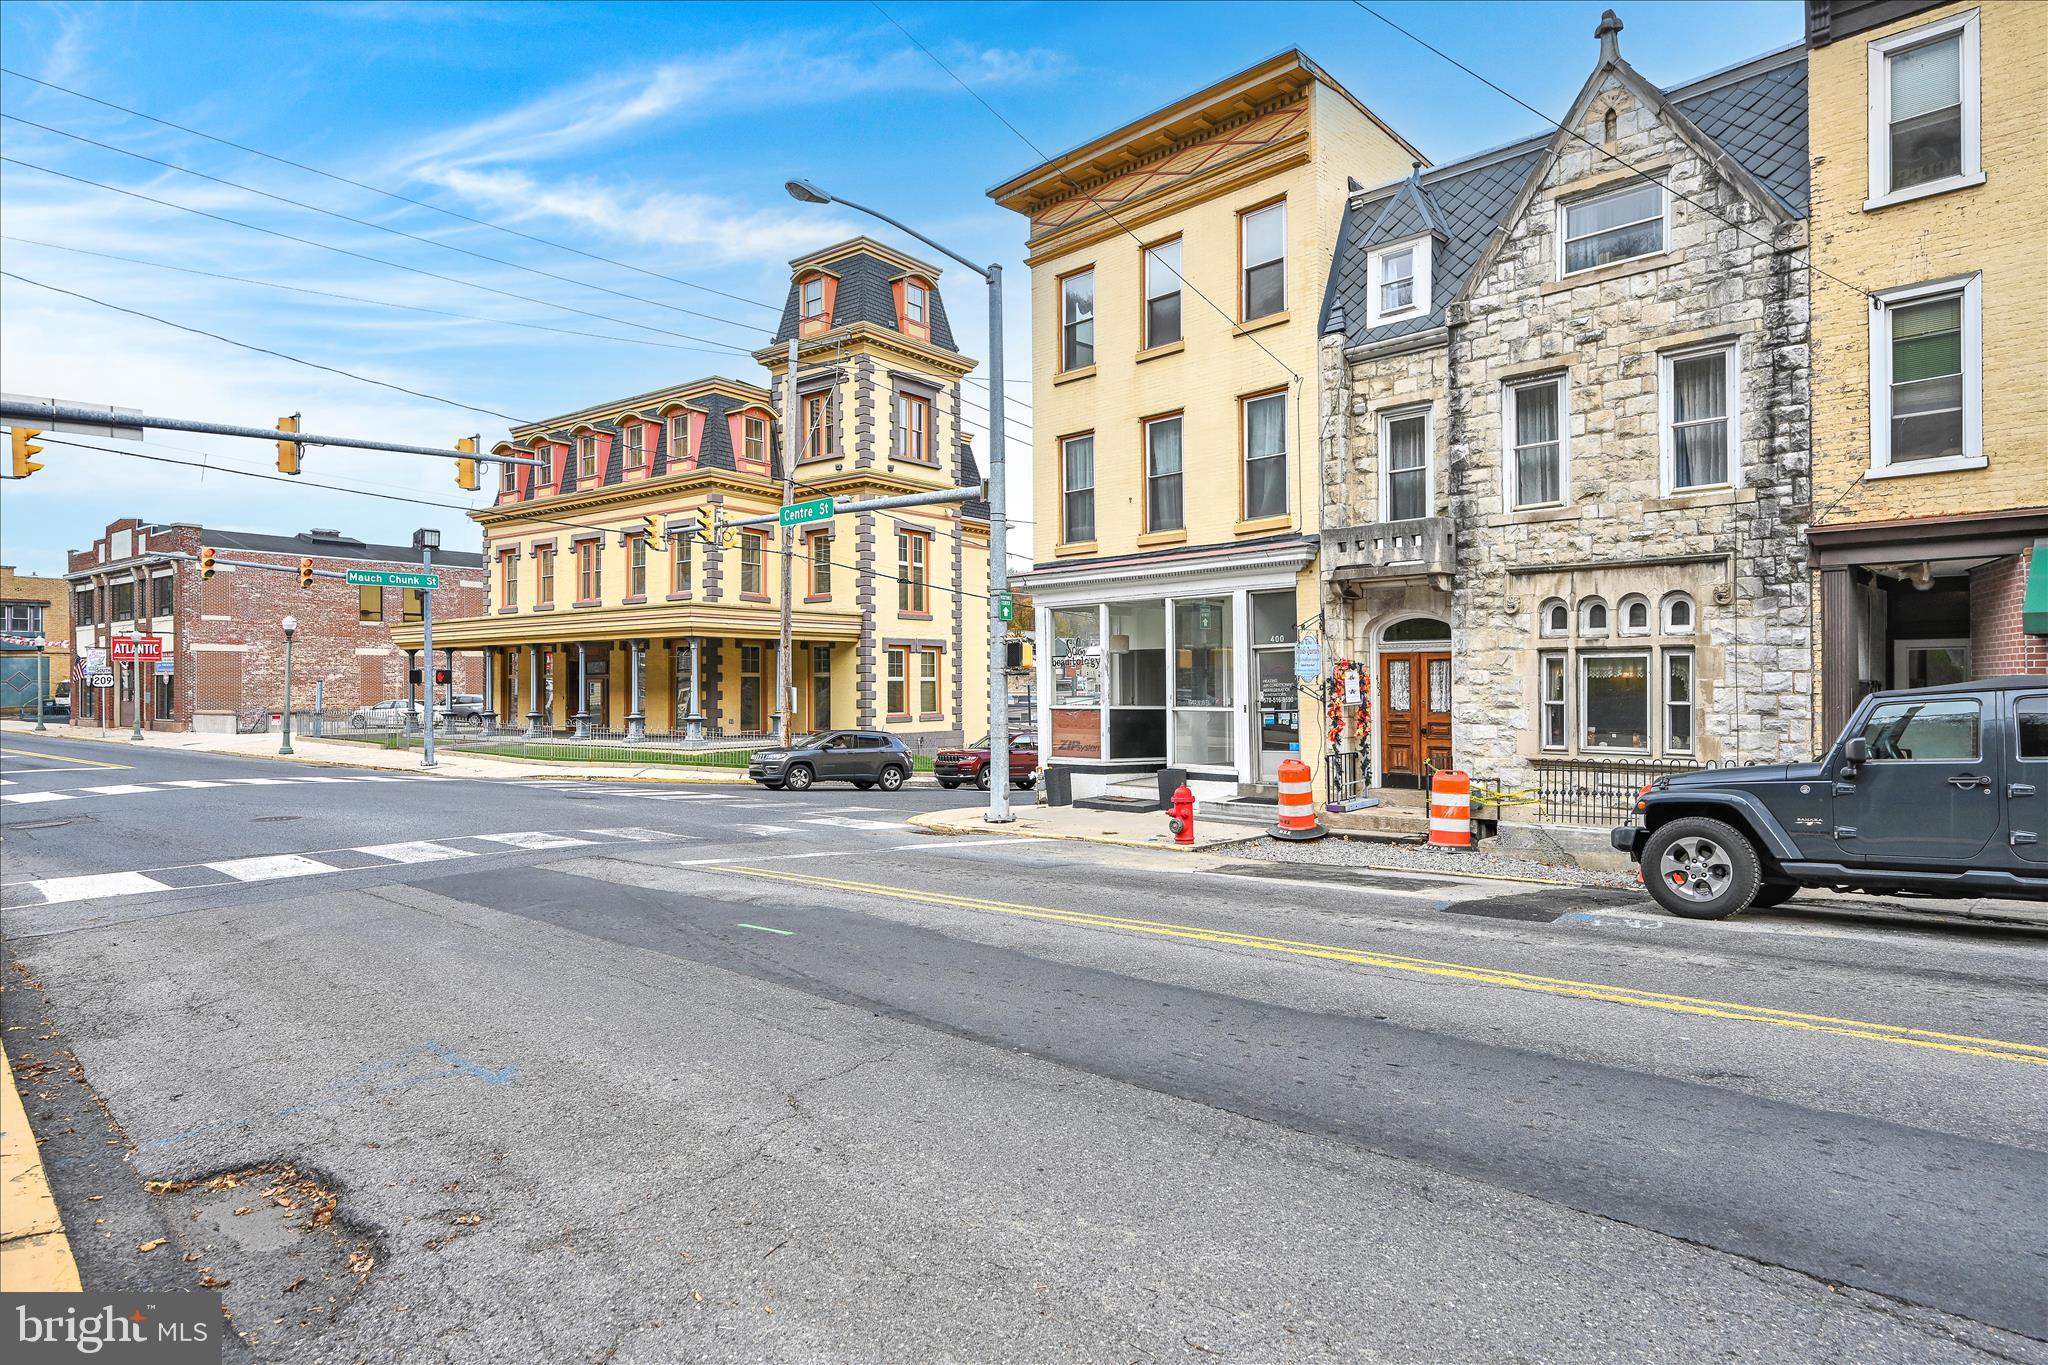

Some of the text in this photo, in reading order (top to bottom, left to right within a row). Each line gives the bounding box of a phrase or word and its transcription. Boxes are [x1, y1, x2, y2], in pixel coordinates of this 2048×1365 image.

[784, 502, 829, 521] Centre St
[349, 572, 437, 586] Mauch Chunk St
[1270, 635, 1285, 643] 400
[94, 676, 112, 685] 209
